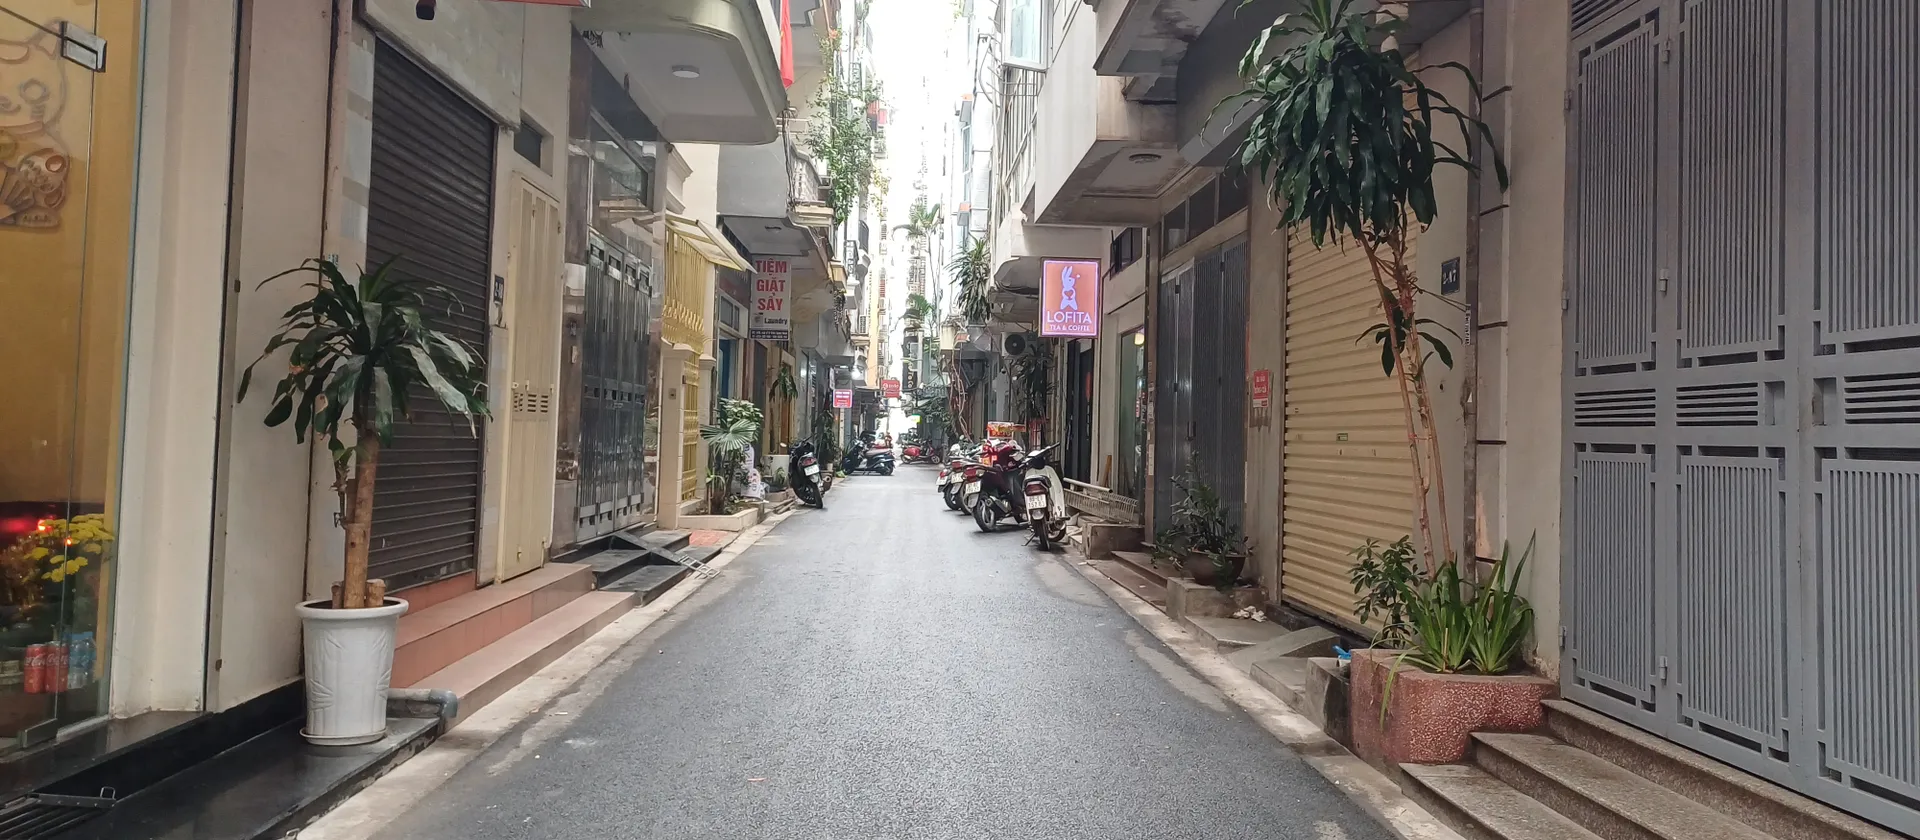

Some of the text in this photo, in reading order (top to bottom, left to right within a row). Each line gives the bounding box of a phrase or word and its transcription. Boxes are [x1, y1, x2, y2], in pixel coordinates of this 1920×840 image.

[755, 257, 787, 276] TIỆM
[756, 276, 786, 295] GIẶT
[764, 317, 788, 325] Laundry
[1047, 311, 1092, 324] LOFITA
